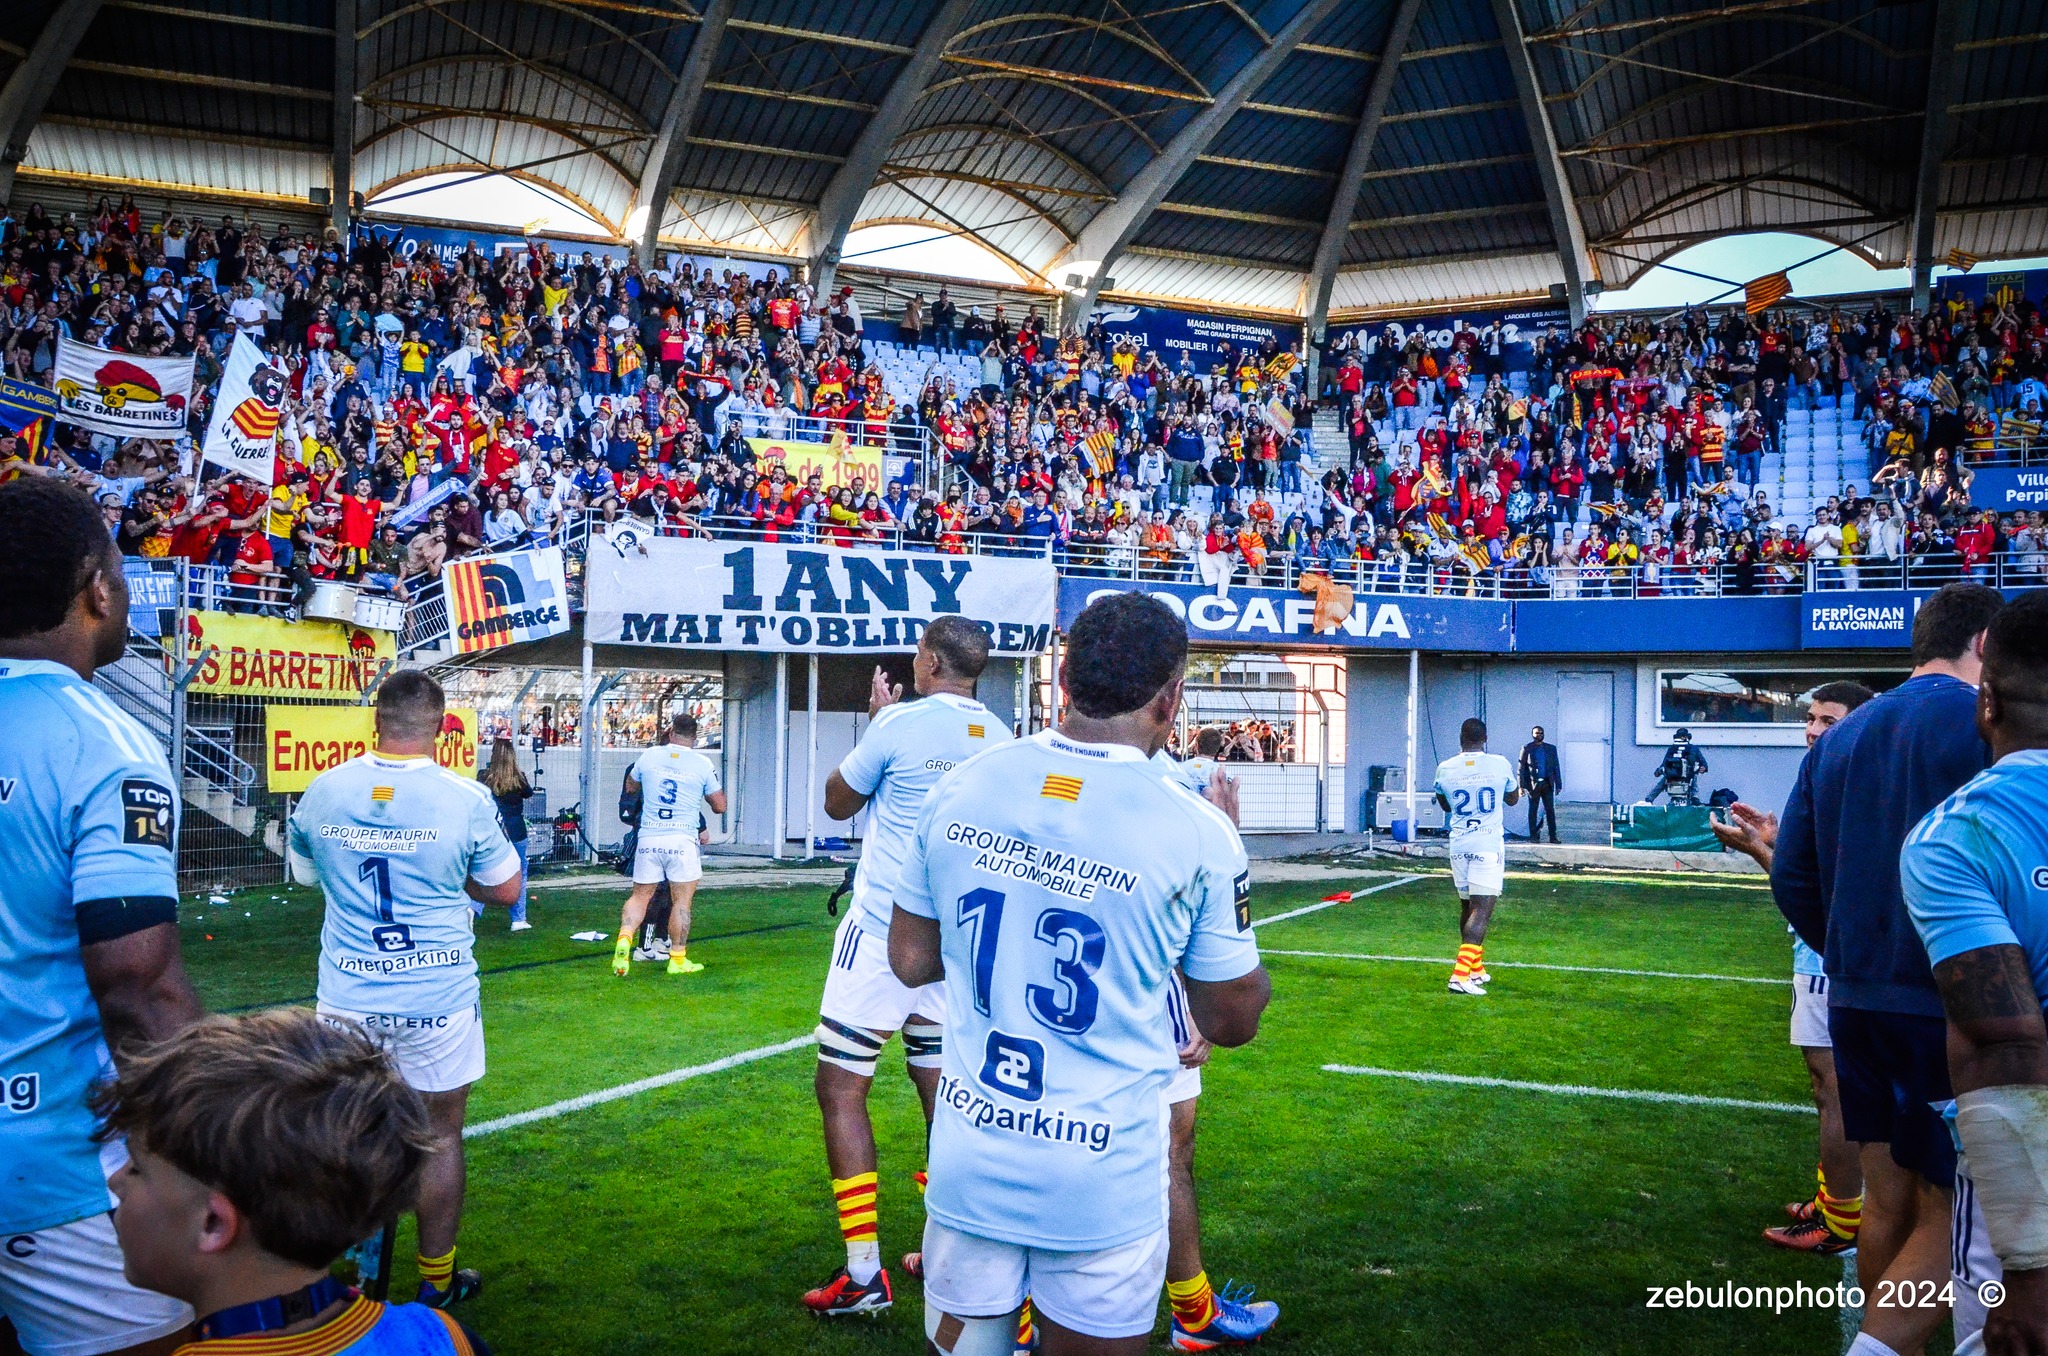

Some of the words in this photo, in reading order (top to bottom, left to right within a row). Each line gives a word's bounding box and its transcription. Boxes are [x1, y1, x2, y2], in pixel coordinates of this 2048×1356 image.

[1989, 274, 2024, 283] USAP
[1186, 318, 1225, 331] MAGASIN
[1225, 324, 1272, 336] PERPIGNAN
[1193, 328, 1209, 336] ZONE
[1210, 330, 1231, 339] GRAND
[1165, 338, 1208, 352] MOBILIER
[2020, 382, 2034, 395] 15
[93, 403, 178, 422] BARRETINES
[722, 546, 763, 611] 1
[775, 550, 973, 614] ANY
[457, 604, 561, 640] GAMBERGE
[619, 612, 723, 645] MAI
[736, 614, 1051, 653] T'OBLIDREM
[1812, 621, 1826, 631] LA
[1828, 620, 1905, 631] RAYONNANTE
[1050, 738, 1074, 754] SEMPRE
[1074, 747, 1109, 759] ENDAVANT
[925, 759, 957, 772] GRO
[128, 788, 171, 806] TOP
[658, 778, 678, 805] 3
[1453, 786, 1496, 818] 20
[320, 824, 381, 841] GROUPE
[382, 828, 438, 842] MAURIN
[341, 839, 417, 852] AUTOMOBILE
[946, 822, 1038, 863] GROUPE
[1040, 850, 1137, 893] MAURIN
[974, 852, 1096, 900] AUTOMOBILE
[1236, 873, 1250, 895] TO
[358, 856, 395, 923] 1
[338, 948, 462, 976] Interparking
[956, 886, 1107, 1036] 13
[939, 1075, 1112, 1153] nterparking
